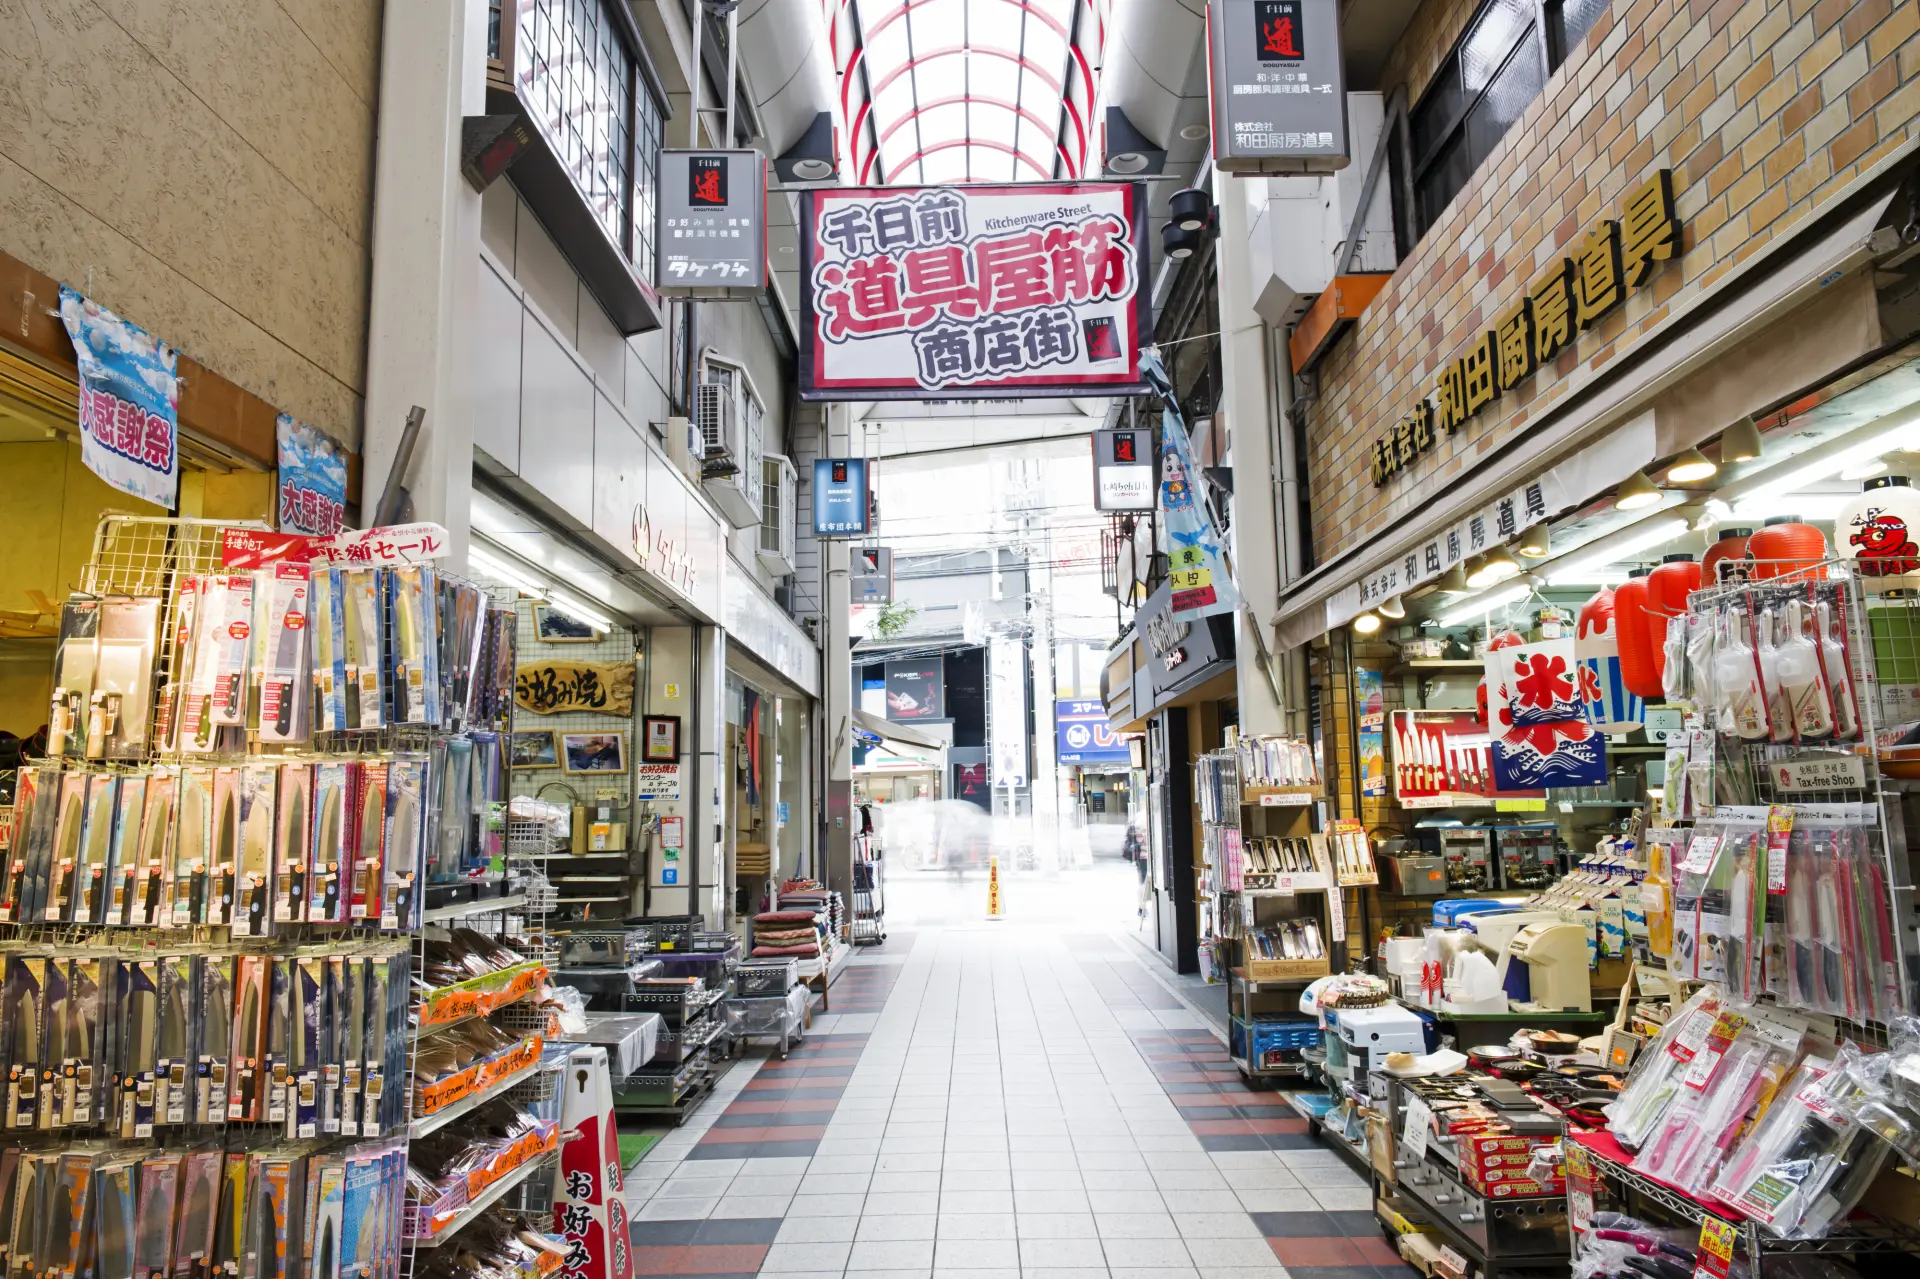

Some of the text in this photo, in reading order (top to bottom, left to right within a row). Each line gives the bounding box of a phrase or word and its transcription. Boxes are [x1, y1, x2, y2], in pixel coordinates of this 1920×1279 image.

[1265, 4, 1293, 13] 千日前
[1234, 121, 1275, 132] 株式会社
[1235, 132, 1335, 149] 和田厨房道具
[828, 199, 963, 253] 千日前
[985, 203, 1093, 231] Kitchenware Street
[668, 261, 750, 278] タケウチ
[823, 220, 1127, 338] 道具屋筋
[917, 308, 1076, 379] 商店街
[1369, 169, 1683, 489] 株式会社 和田厨房道具
[80, 378, 173, 470] 大感謝祭
[225, 536, 264, 551] 手造り包丁
[819, 522, 862, 532] 座布団本舗
[1362, 481, 1547, 602] 株式会社 和田厨房道具
[515, 667, 607, 708] お好み焼
[1514, 653, 1573, 710] 氷
[1796, 774, 1856, 788] Tax-free Shop
[562, 1170, 594, 1279] お好み
